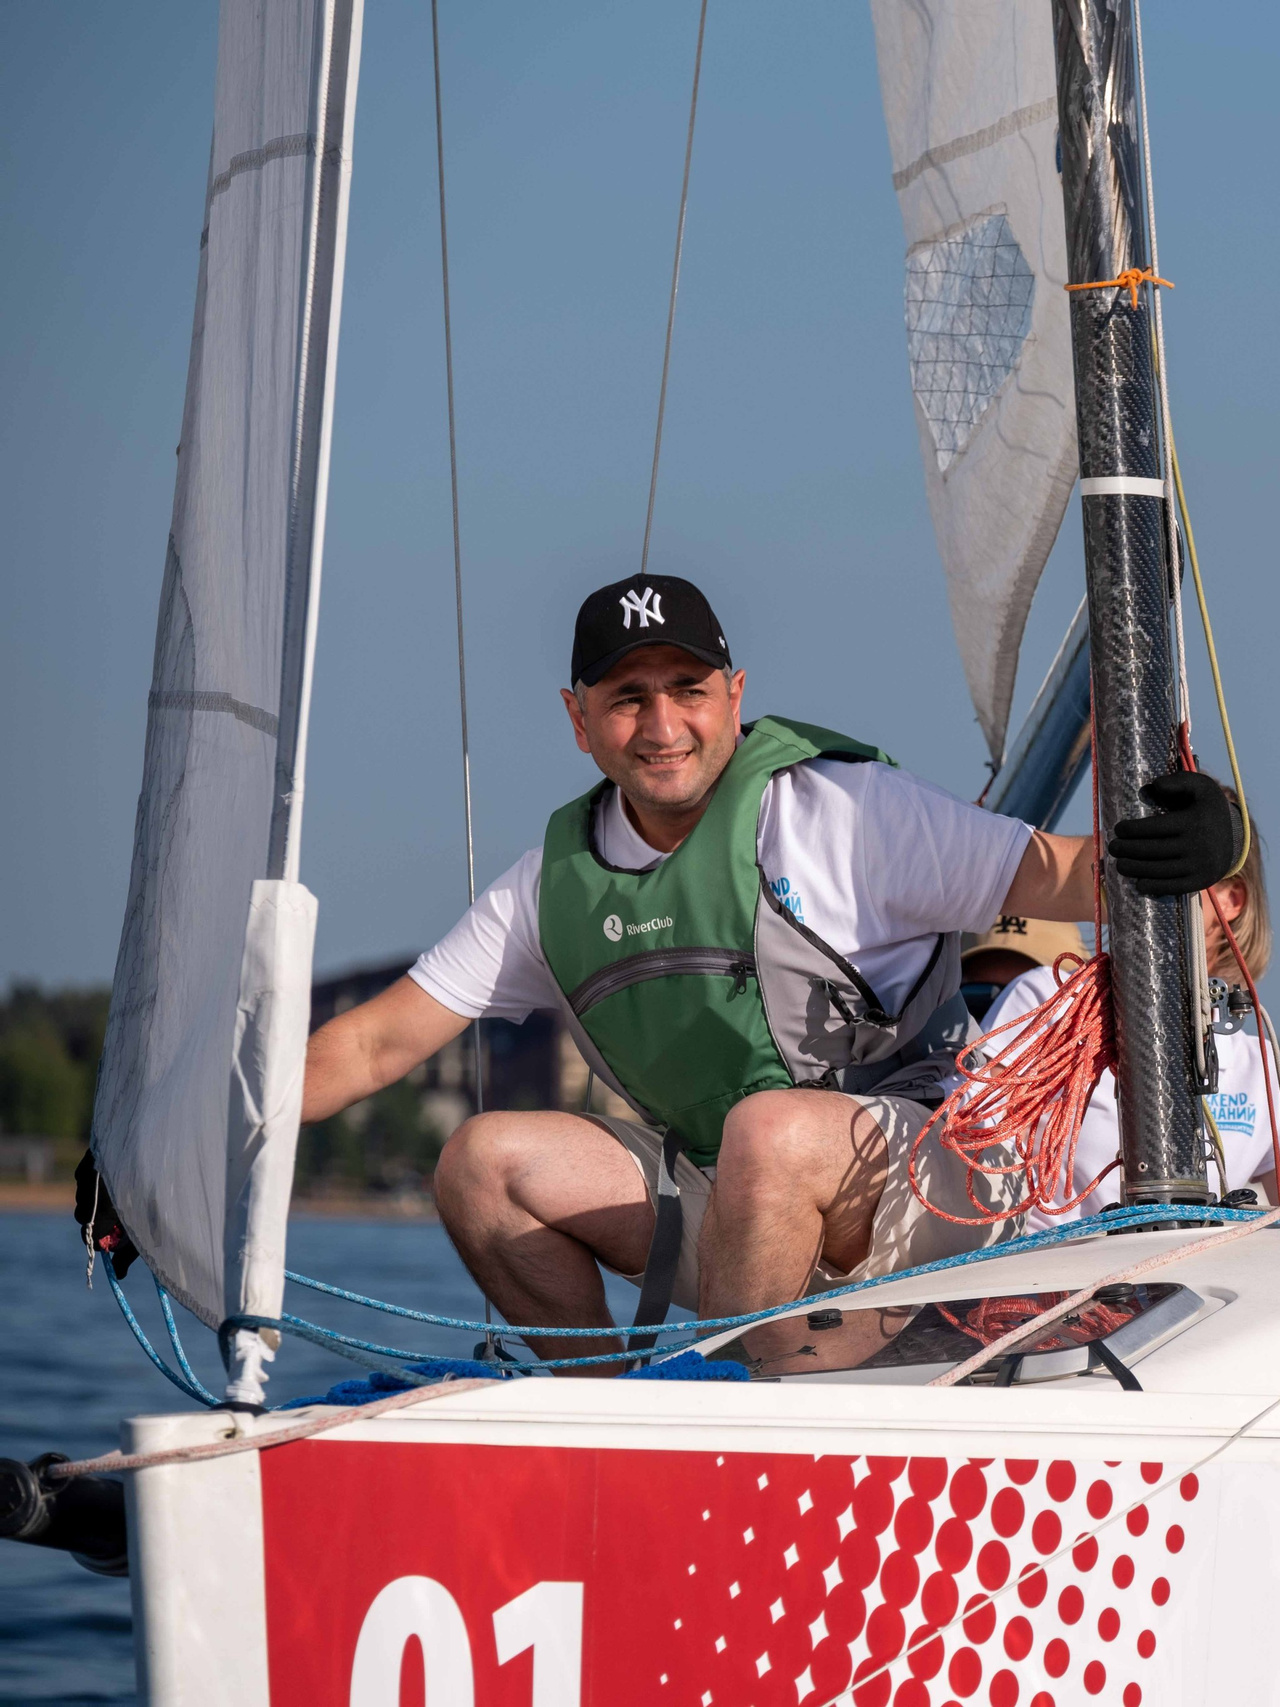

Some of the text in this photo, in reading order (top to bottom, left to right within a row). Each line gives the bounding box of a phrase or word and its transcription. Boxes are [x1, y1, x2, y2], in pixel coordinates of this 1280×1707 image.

[619, 587, 665, 629] NY
[626, 916, 673, 935] RiverClub
[349, 1575, 584, 1707] 01
